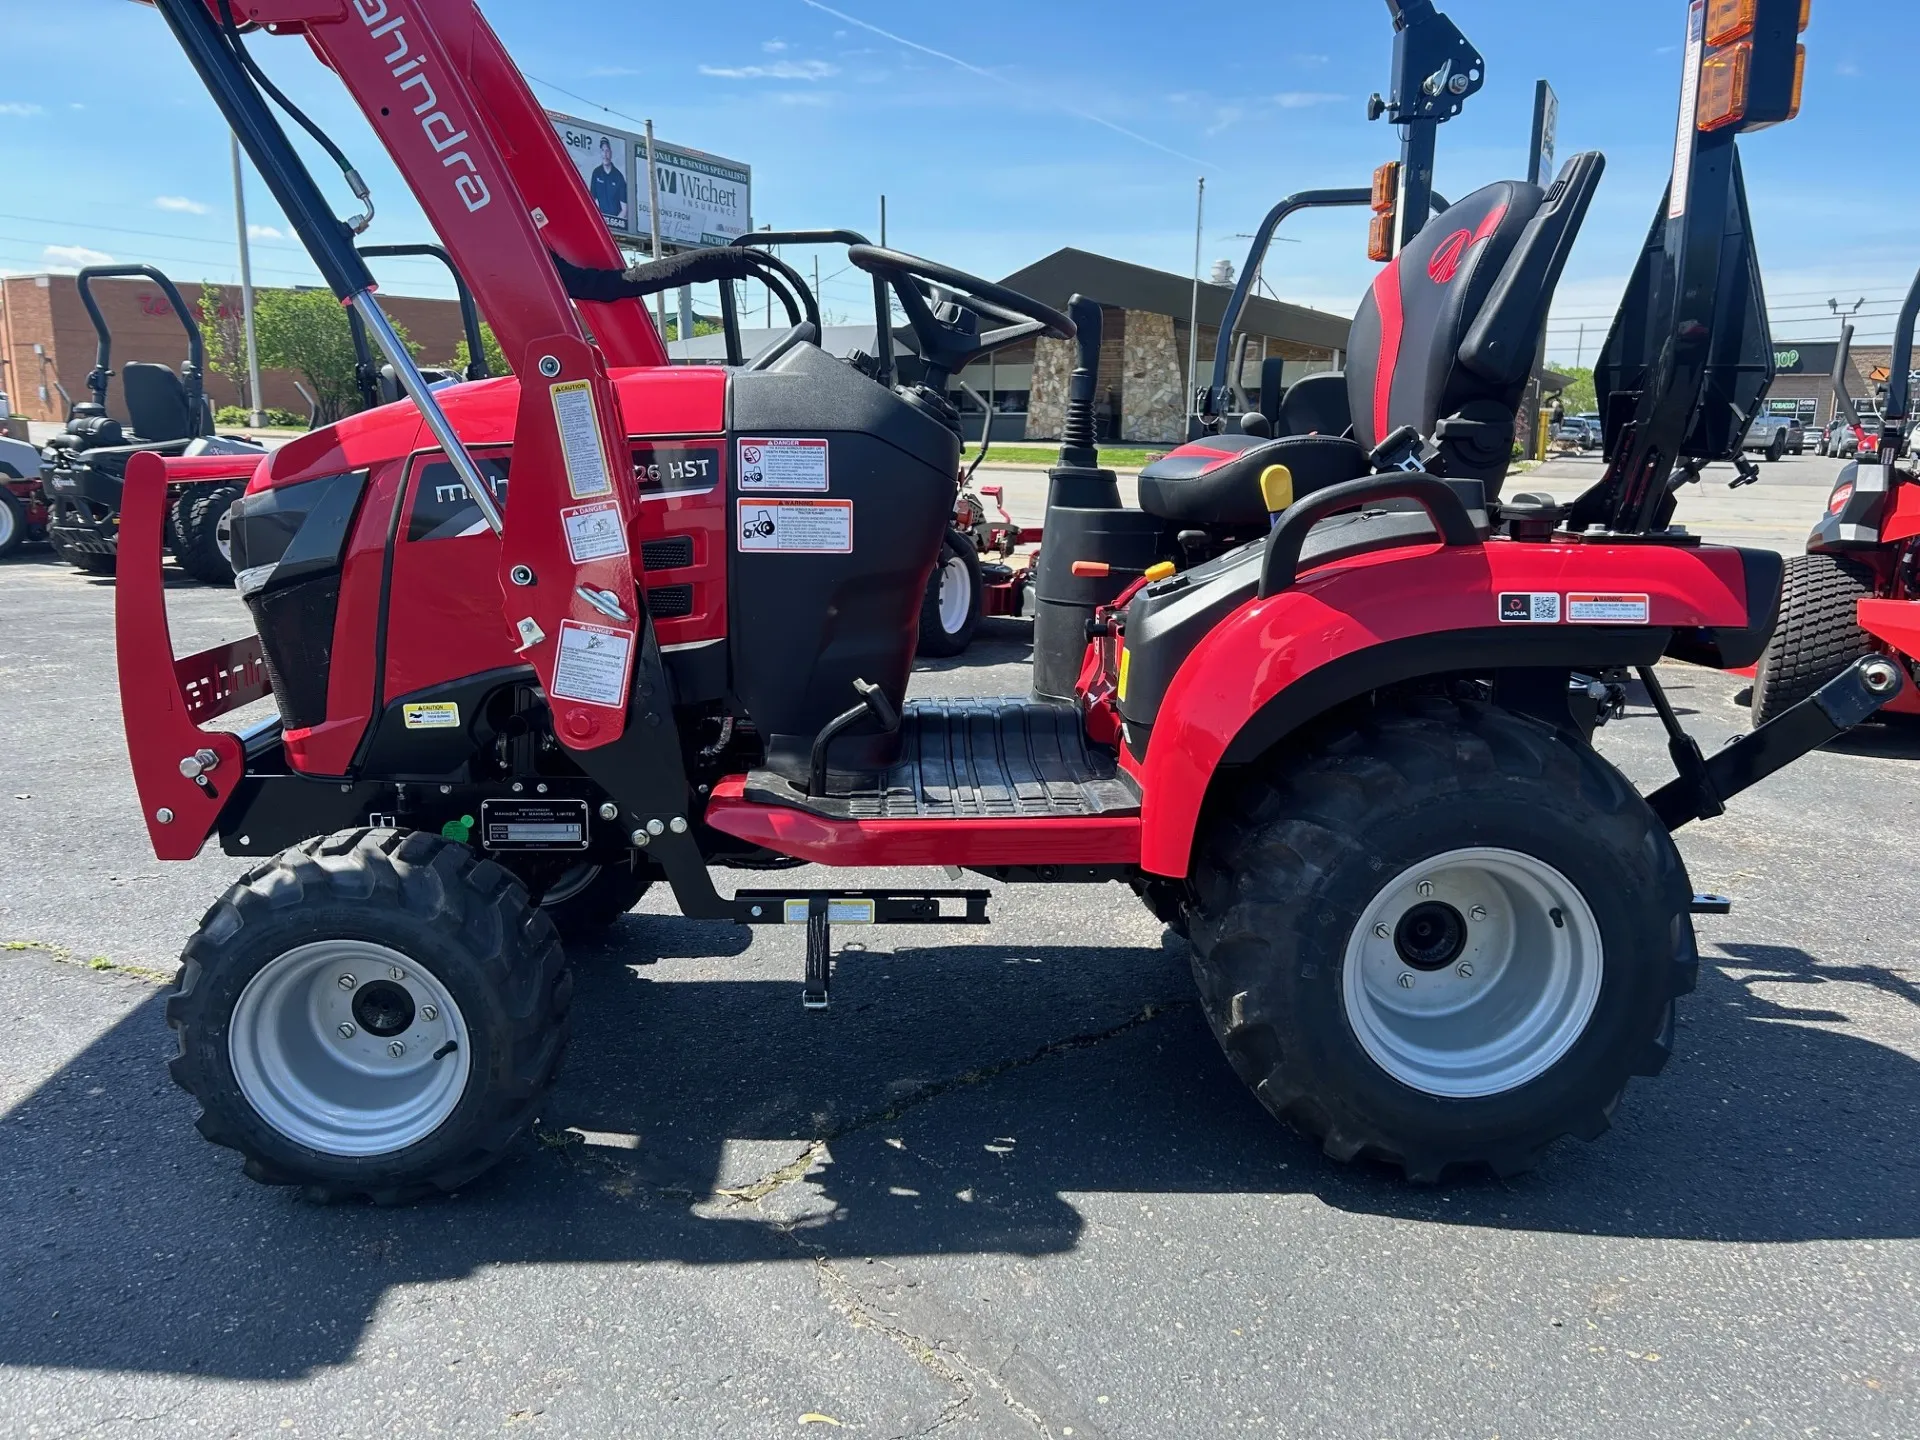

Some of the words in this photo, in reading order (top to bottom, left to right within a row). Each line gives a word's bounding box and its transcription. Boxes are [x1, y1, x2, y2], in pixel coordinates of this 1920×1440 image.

[566, 130, 592, 150] Sell?
[636, 147, 671, 164] PEONAL
[673, 155, 679, 165] &
[680, 158, 710, 173] BUSINESS
[710, 166, 746, 182] SPECIALISTS
[679, 172, 737, 209] Wichert
[639, 203, 673, 217] SOLONS
[673, 211, 690, 221] FROM
[682, 199, 736, 217] INSURANCE
[1773, 350, 1799, 368] HOP
[561, 383, 586, 391] CAUTION
[1772, 402, 1796, 410] TOBACCO
[668, 460, 709, 479] HST
[579, 503, 608, 514] DANGER
[587, 625, 614, 635] DANGER
